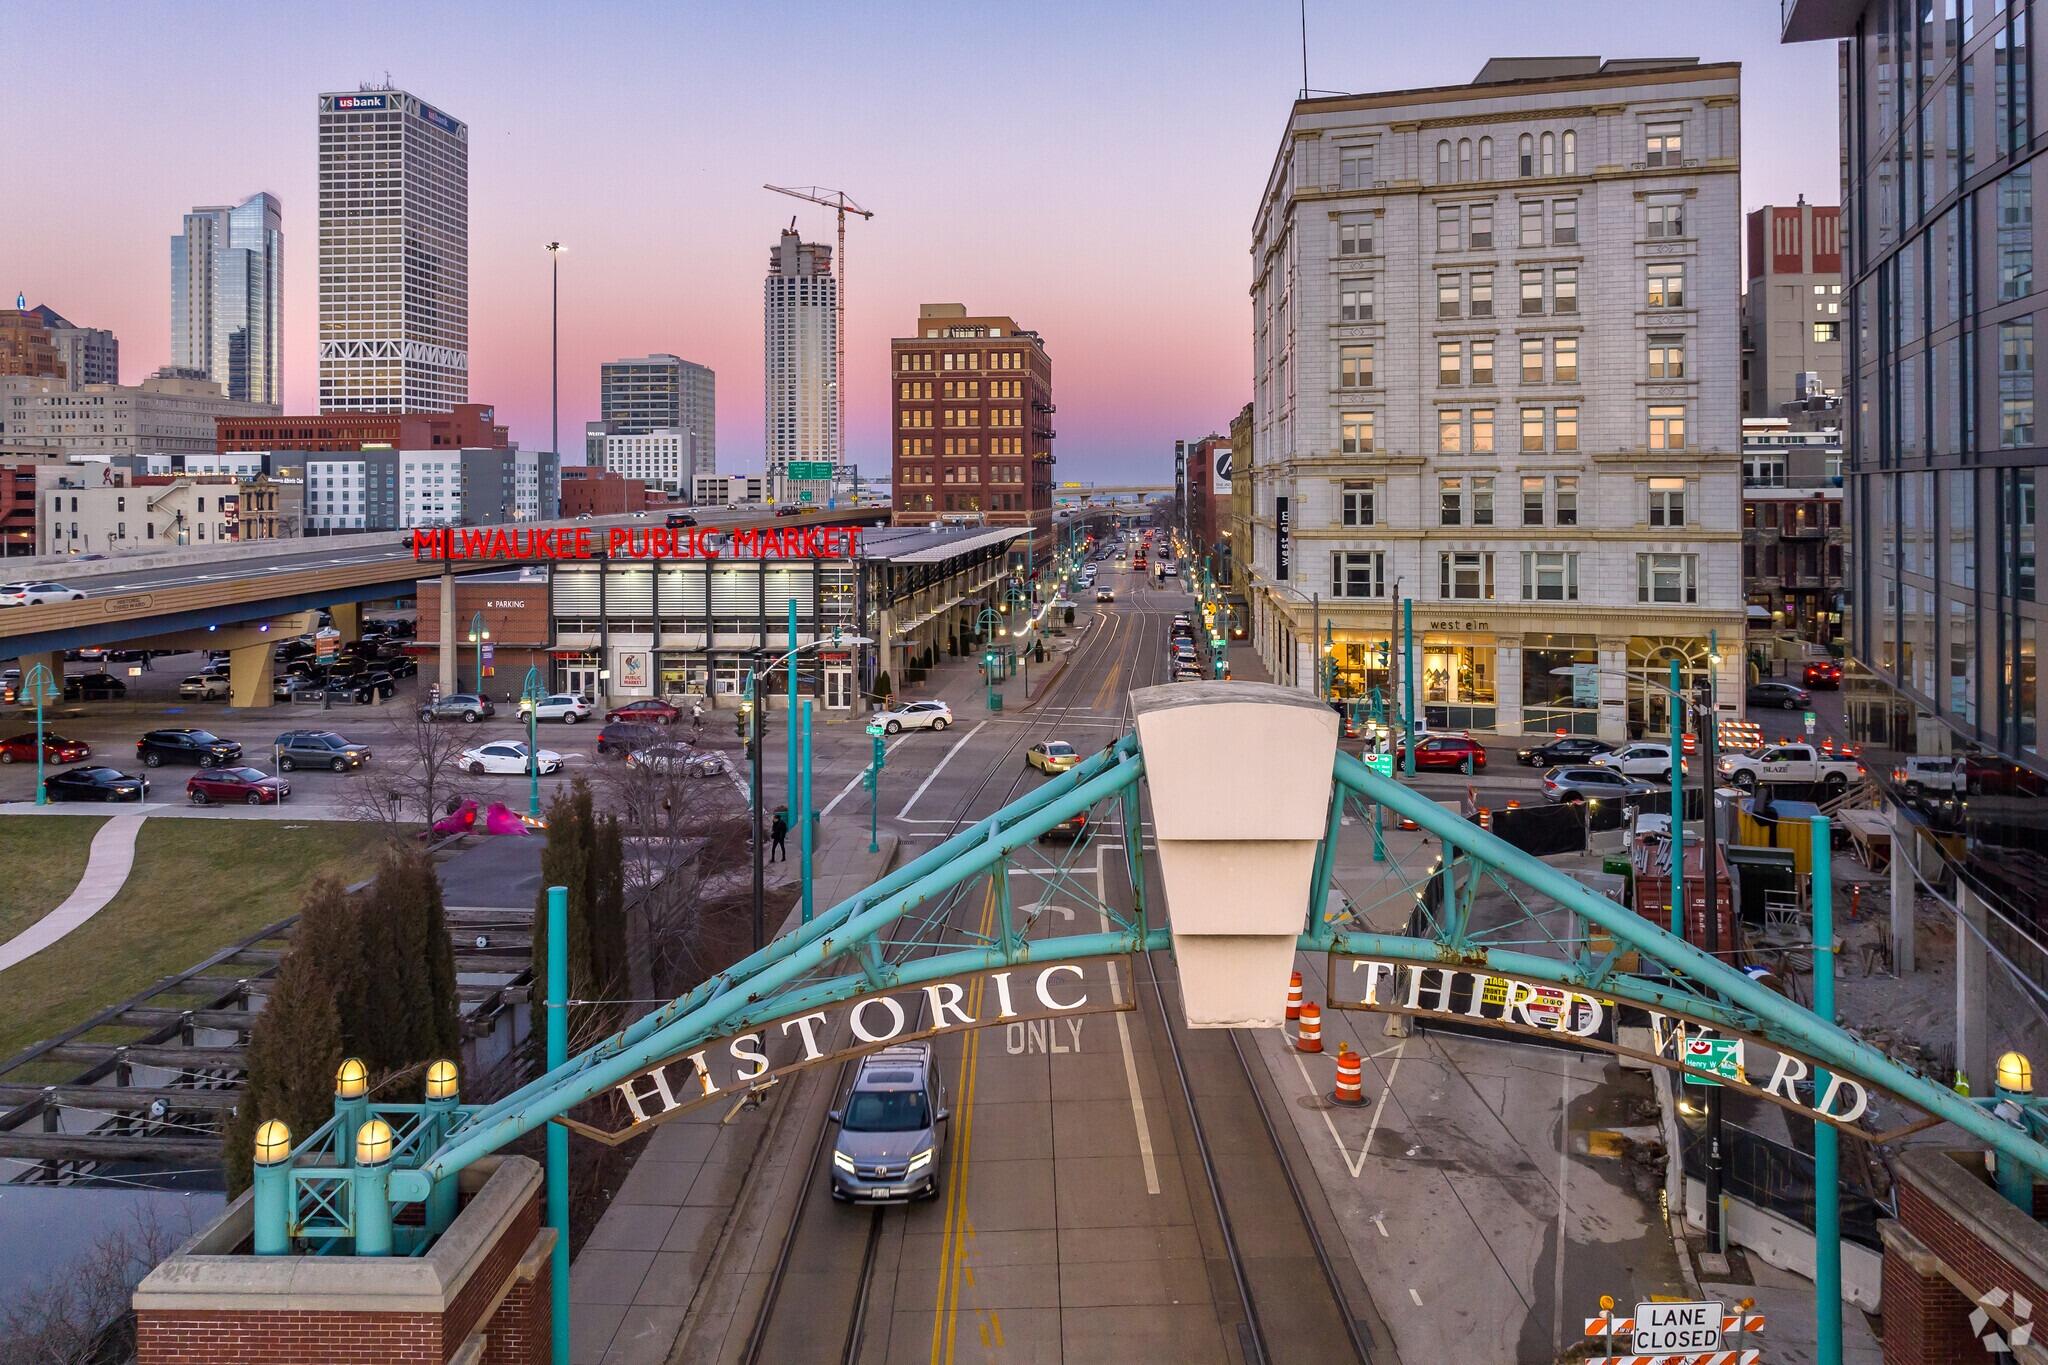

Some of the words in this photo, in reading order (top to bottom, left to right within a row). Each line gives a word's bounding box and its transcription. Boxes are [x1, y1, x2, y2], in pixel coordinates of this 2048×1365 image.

[339, 97, 381, 106] usbank
[413, 528, 592, 559] MILWAUKEE
[609, 527, 720, 559] PUBLIC
[733, 527, 864, 558] MARKET
[1430, 620, 1460, 630] west
[1466, 619, 1489, 630] elm
[616, 965, 1087, 1126] HISTORIC
[1006, 1018, 1084, 1055] ONLY
[1353, 960, 1603, 1037] THIRD
[1649, 1011, 1868, 1122] WARD
[1687, 1060, 1706, 1069] Henry
[1652, 1309, 1706, 1326] LANE
[1637, 1330, 1718, 1348] CLOSED
